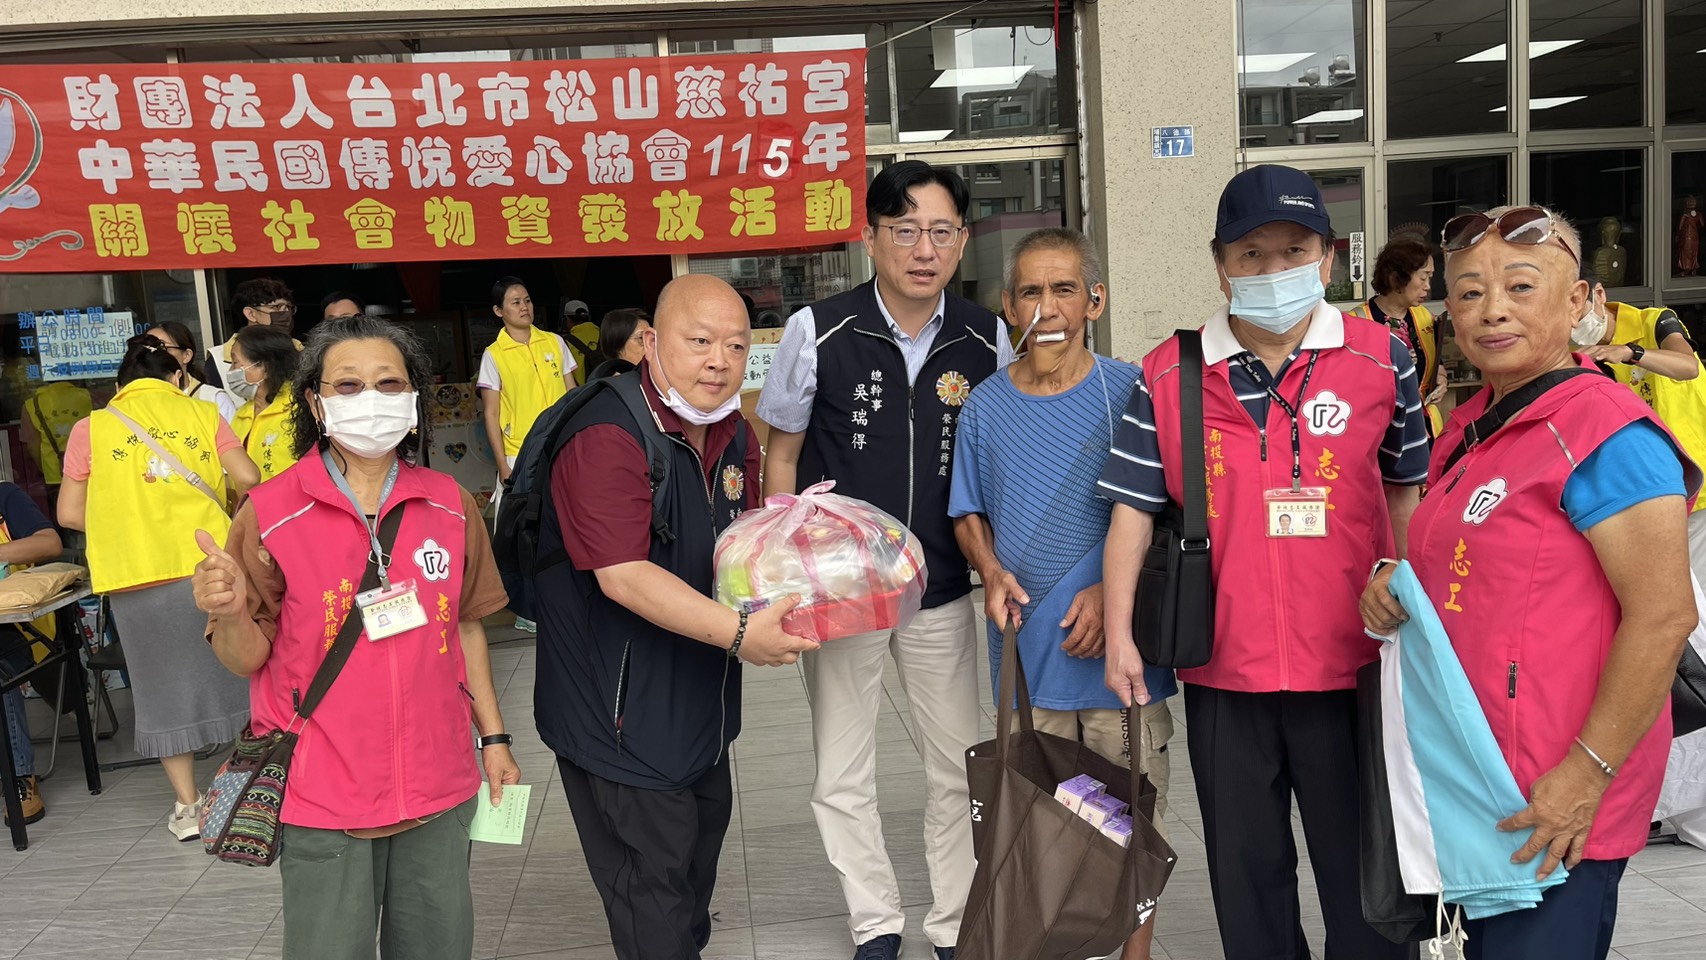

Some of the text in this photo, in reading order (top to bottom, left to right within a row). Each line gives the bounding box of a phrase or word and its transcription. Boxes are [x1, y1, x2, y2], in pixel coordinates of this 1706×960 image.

[63, 59, 850, 131] 財團法人台北市松山慈祐宮
[78, 120, 851, 194] 中華民國傳悅愛心協會115年
[1167, 139, 1185, 156] 17
[88, 178, 852, 257] 關懷社會物資發放活動
[1352, 233, 1363, 265] 服務鈴
[18, 307, 105, 330] 辦公時間
[20, 335, 52, 355] 平日
[851, 383, 869, 450] 吳瑞得
[870, 369, 883, 412] 總幹事
[1209, 428, 1226, 477] 南投縣
[1444, 536, 1473, 613] 志工
[436, 592, 451, 655] 志工
